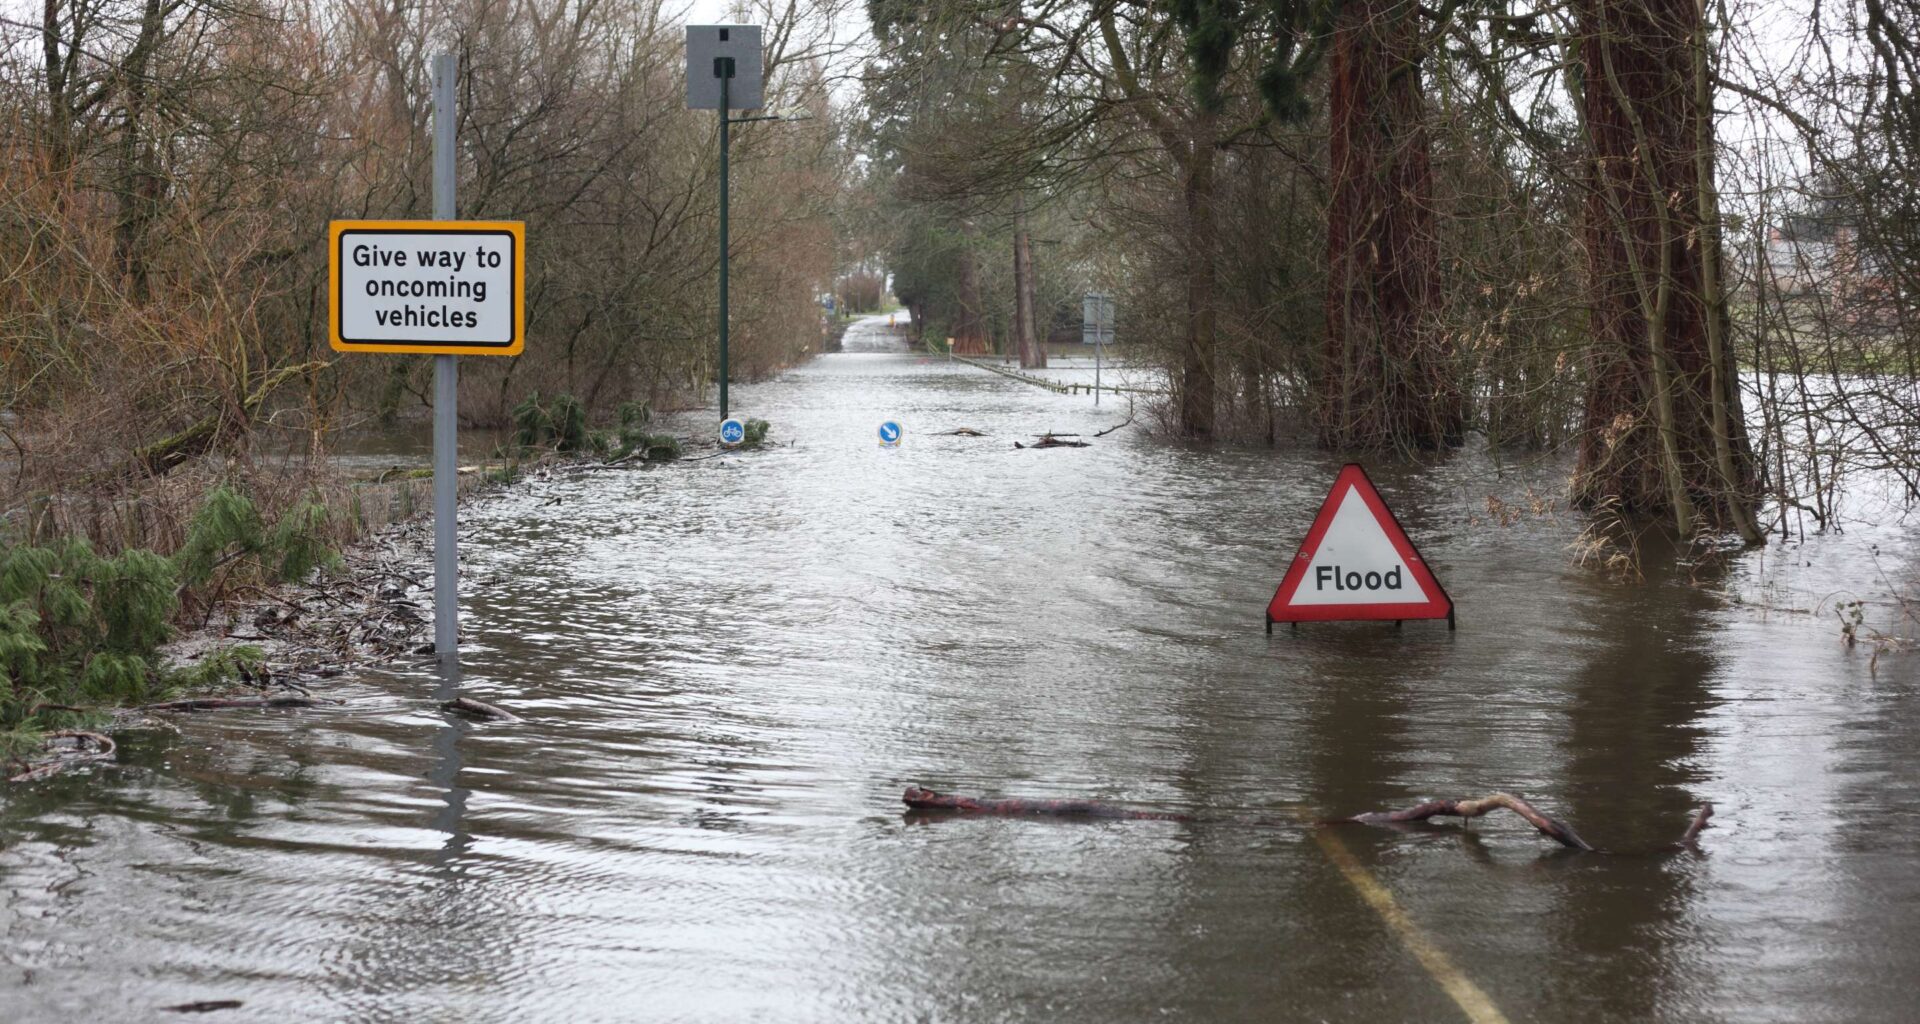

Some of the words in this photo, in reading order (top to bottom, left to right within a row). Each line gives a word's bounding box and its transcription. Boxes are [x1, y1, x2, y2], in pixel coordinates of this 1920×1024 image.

[353, 244, 407, 267] Give
[417, 250, 466, 272] way
[476, 246, 501, 268] to
[366, 275, 487, 302] oncoming
[375, 305, 478, 328] vehicles
[1316, 565, 1402, 591] Flood
